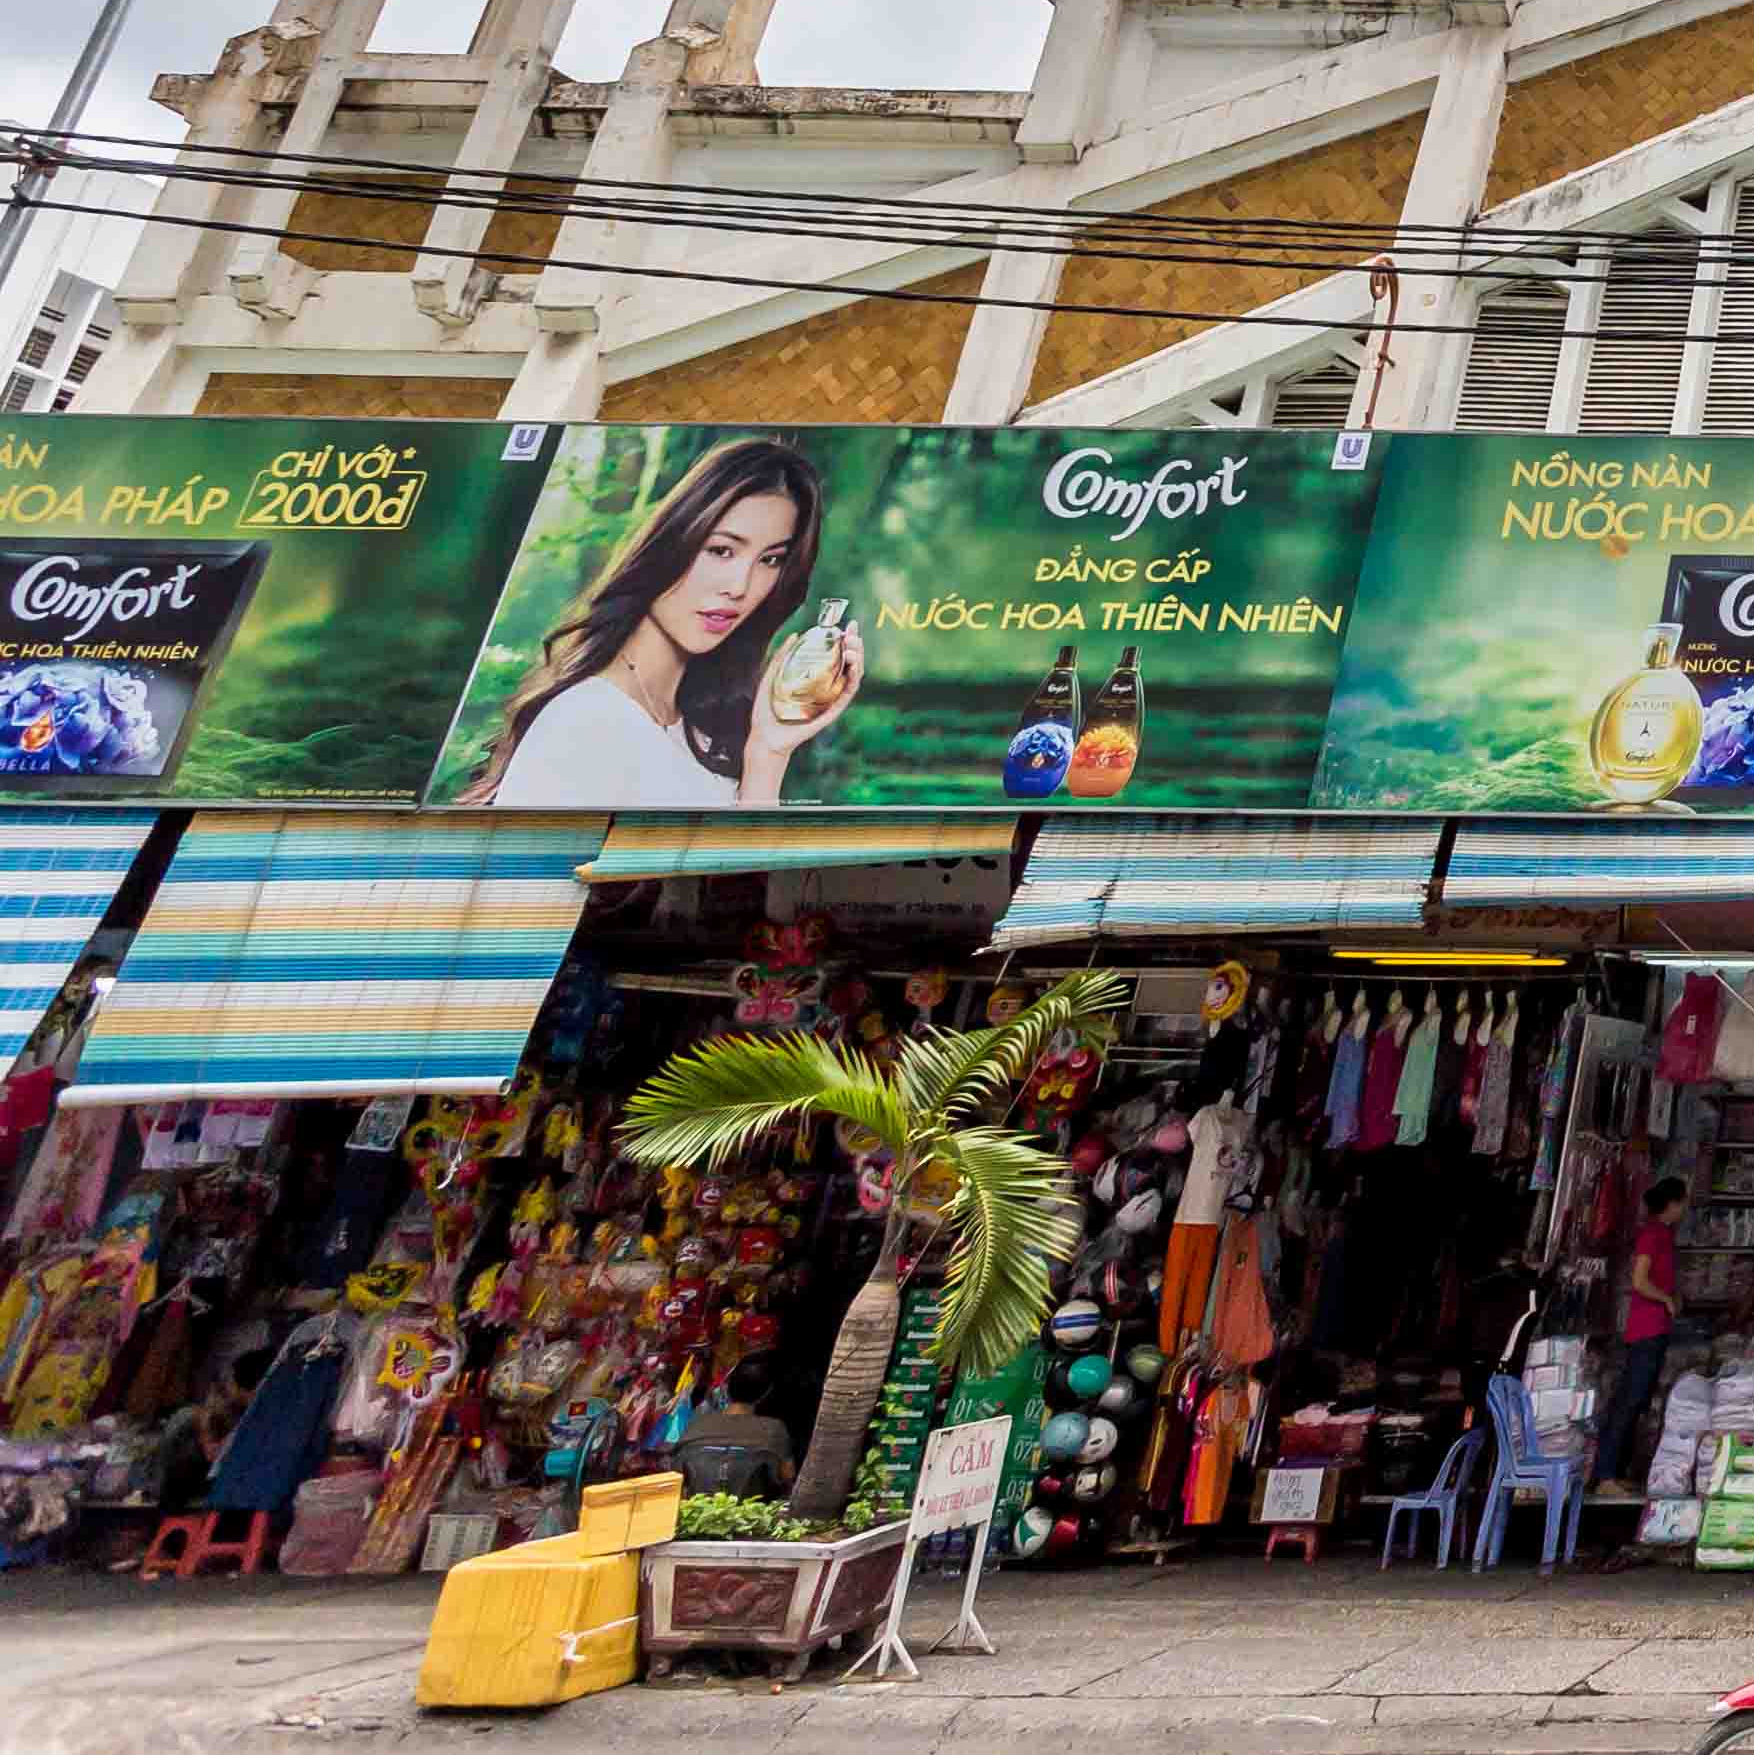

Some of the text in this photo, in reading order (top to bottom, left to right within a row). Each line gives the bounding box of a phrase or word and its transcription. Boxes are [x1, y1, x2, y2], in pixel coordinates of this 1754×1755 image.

[272, 444, 335, 478] CHỈ
[1511, 450, 1711, 490] NỒNG NÀN
[100, 475, 230, 526] PHÁP
[246, 479, 417, 526] 2000đ
[1041, 446, 1249, 542] Comfort
[1501, 491, 1650, 542] NƯỚC
[1033, 544, 1212, 584] ĐẲNG CẤP
[12, 555, 202, 641] Comfort
[876, 592, 1342, 635] NƯỚC HOA THIÊN NHIÊN
[20, 643, 64, 658] HOA
[72, 640, 131, 659] THIÊN
[135, 640, 200, 660] NHIÊN
[1684, 655, 1740, 674] NƯỚC
